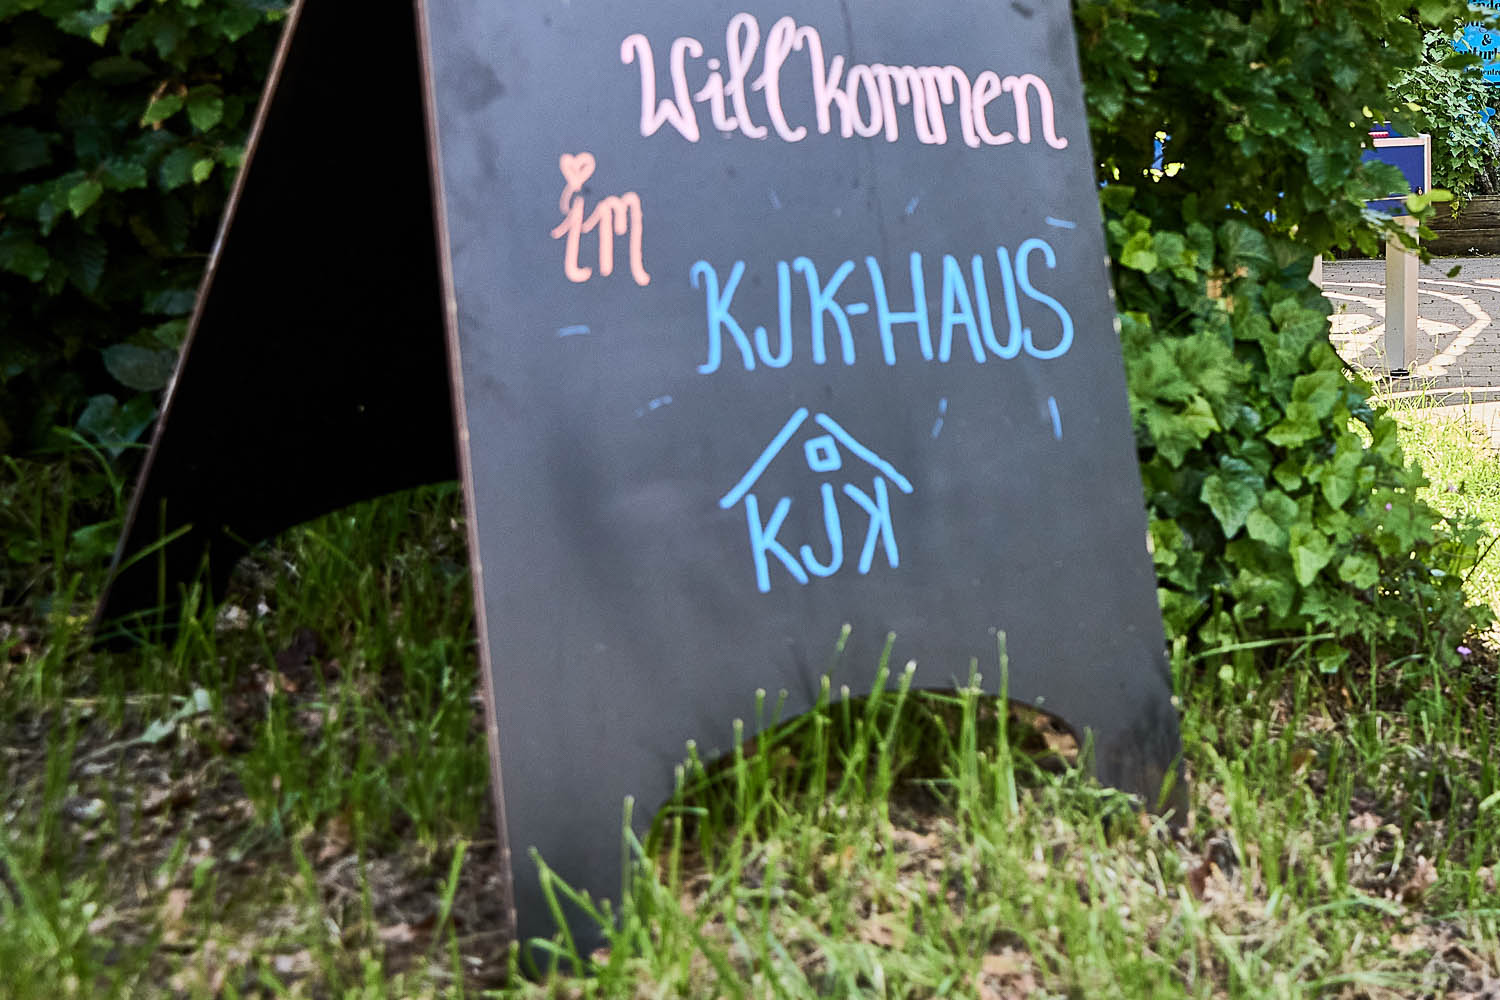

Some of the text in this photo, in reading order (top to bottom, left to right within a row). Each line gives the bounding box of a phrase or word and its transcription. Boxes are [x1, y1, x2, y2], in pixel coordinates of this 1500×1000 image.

[620, 12, 1069, 149] Willkommen
[1481, 33, 1492, 46] &
[690, 237, 1075, 375] KJK-HAUS
